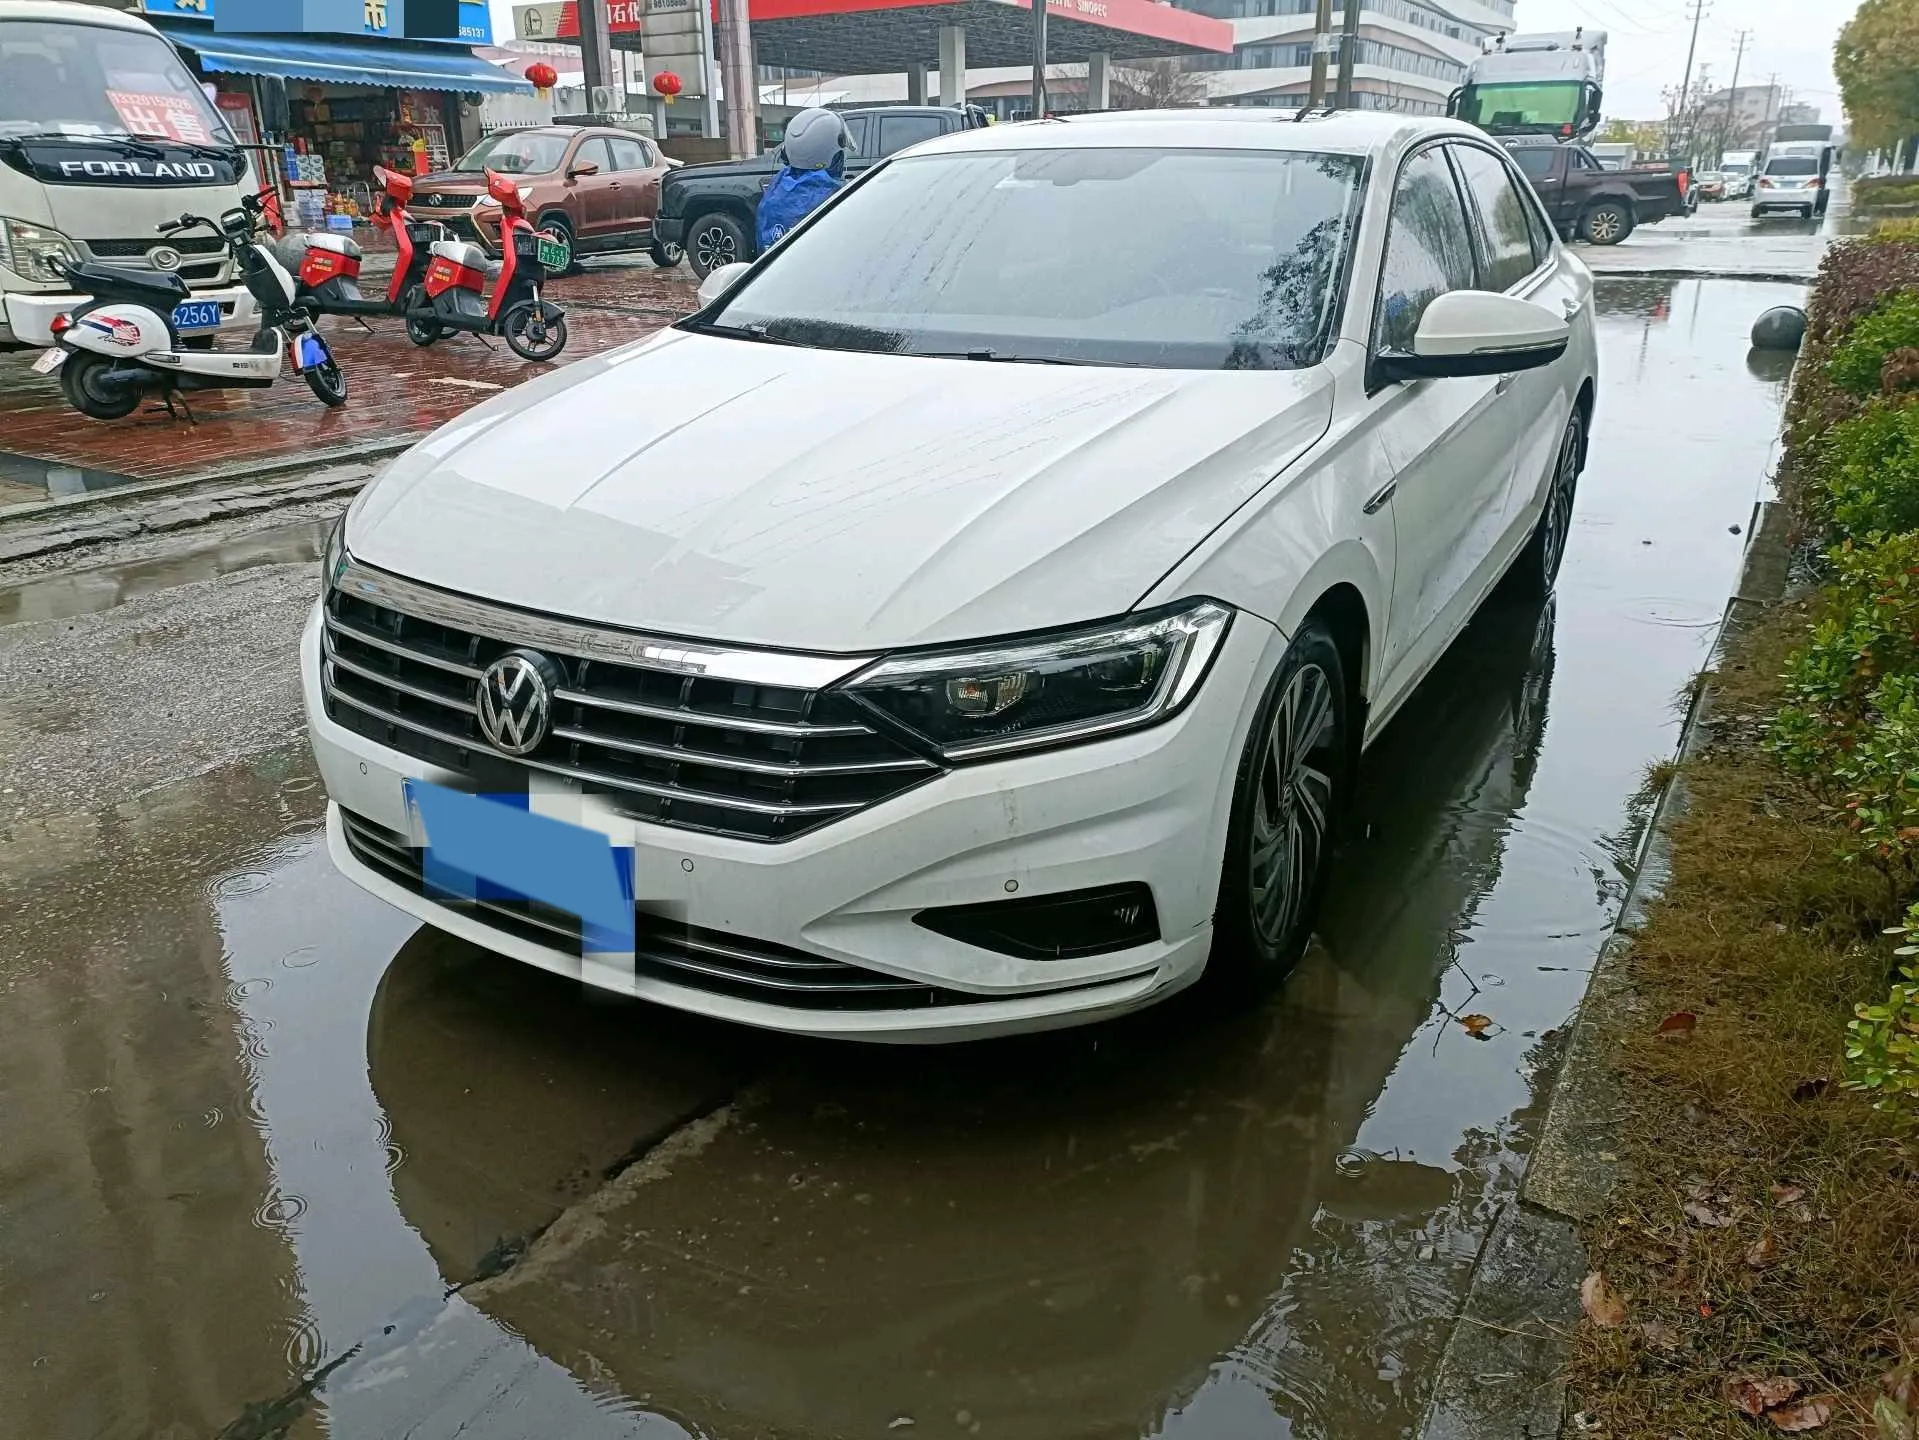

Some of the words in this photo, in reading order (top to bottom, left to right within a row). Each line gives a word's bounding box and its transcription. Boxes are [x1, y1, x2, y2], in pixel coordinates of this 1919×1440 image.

[607, 2, 640, 24] 石化
[118, 106, 206, 141] 出售
[59, 161, 215, 177] FORLAND
